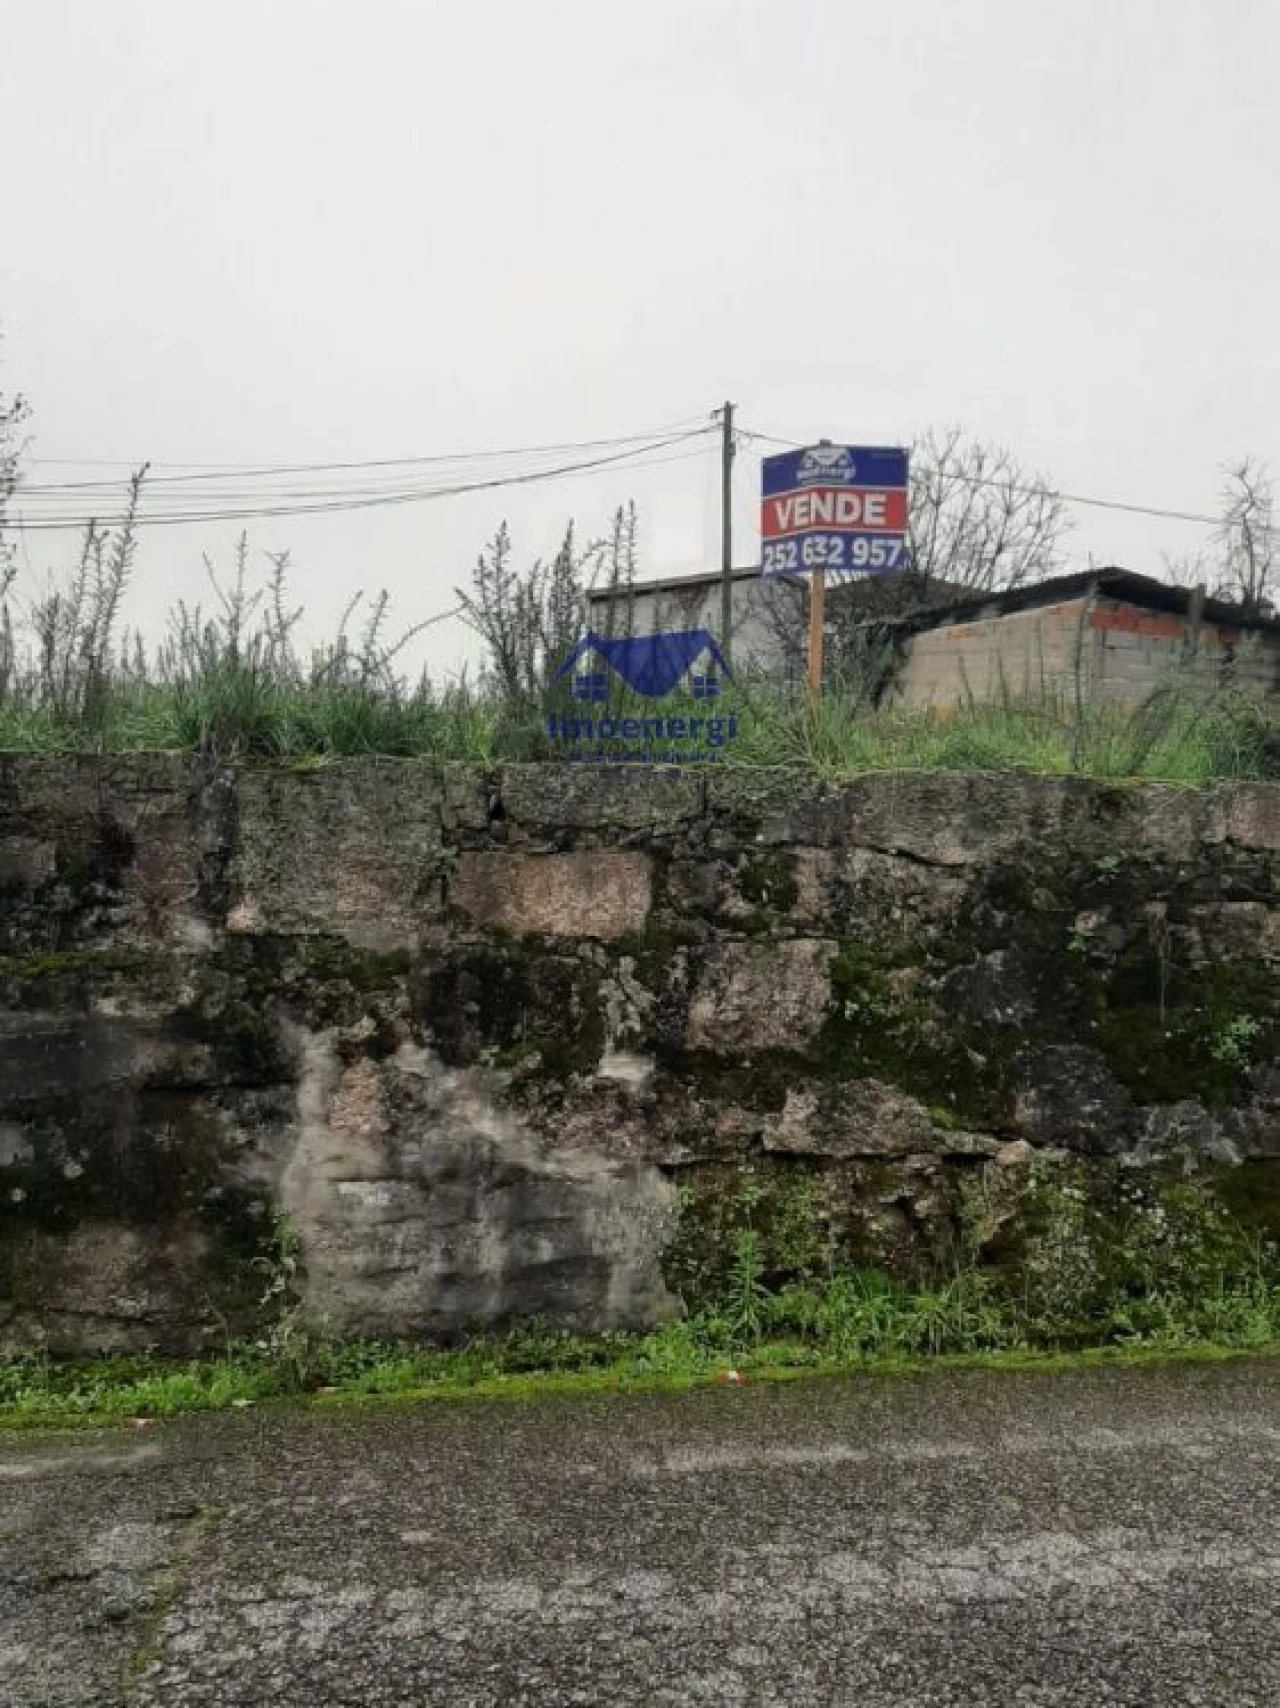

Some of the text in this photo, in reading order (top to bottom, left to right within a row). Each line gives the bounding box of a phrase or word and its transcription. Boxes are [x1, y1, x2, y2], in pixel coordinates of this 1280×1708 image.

[775, 491, 888, 531] VENDE
[763, 535, 903, 574] 252 632 957
